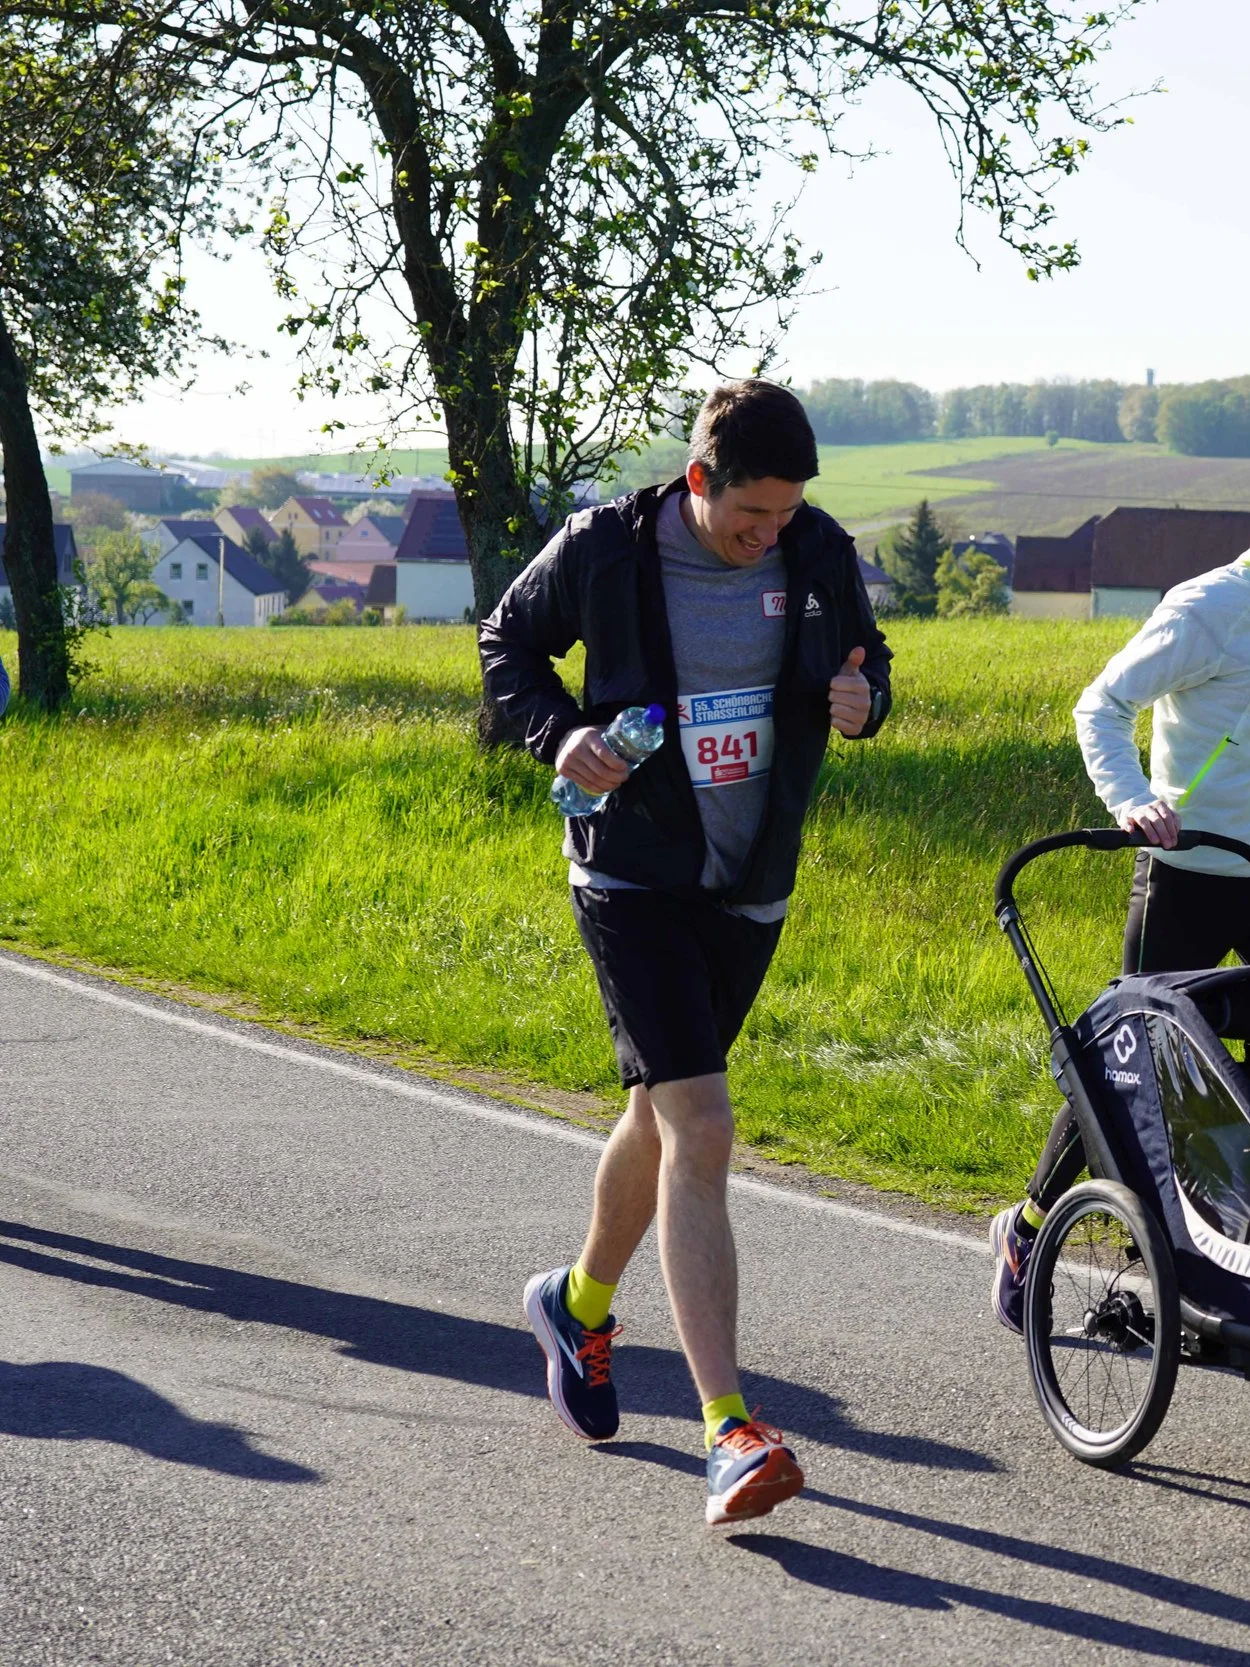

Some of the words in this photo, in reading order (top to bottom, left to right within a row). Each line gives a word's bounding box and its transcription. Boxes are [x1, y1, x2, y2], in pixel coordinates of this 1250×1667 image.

[695, 700, 710, 711] 55.
[713, 692, 773, 709] SCHÖNBACHE
[696, 704, 766, 722] STRASSENLAUF
[697, 731, 757, 764] 841
